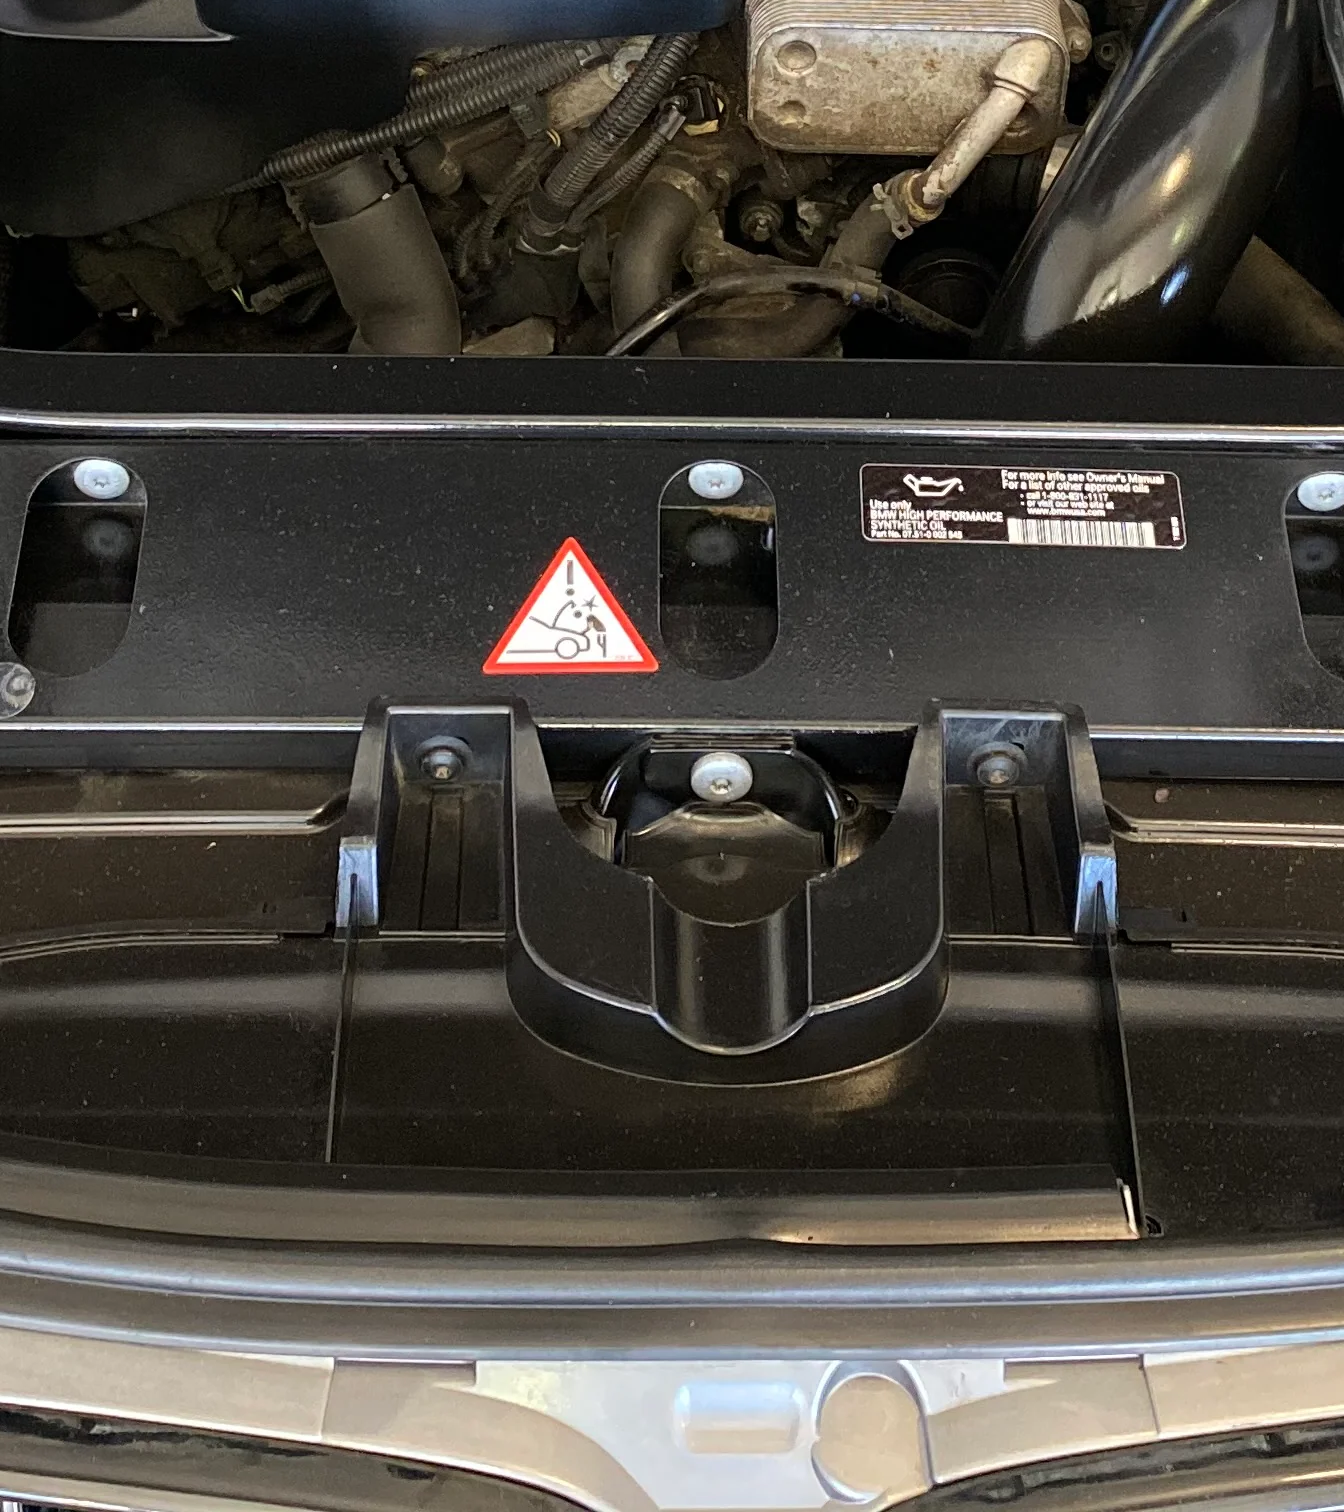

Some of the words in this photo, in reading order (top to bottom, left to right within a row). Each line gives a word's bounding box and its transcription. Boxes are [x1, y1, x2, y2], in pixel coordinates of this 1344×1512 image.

[1001, 469, 1018, 480] For
[1019, 472, 1046, 482] more
[1067, 474, 1085, 482] see
[1086, 472, 1127, 484] Owner's
[1127, 473, 1165, 485] Manual
[1002, 479, 1019, 490] For
[1028, 480, 1043, 491] list
[1044, 480, 1056, 491] of
[1056, 481, 1084, 492] other
[1084, 482, 1131, 494] approved
[1132, 484, 1150, 494] oils
[869, 498, 889, 509] Use
[890, 499, 913, 513] only
[869, 509, 898, 520] BMW
[898, 509, 925, 520] HIGH
[926, 510, 1004, 523] PERFORMANCE
[870, 520, 929, 531] SYNTHETIC
[929, 520, 947, 531] OIL
